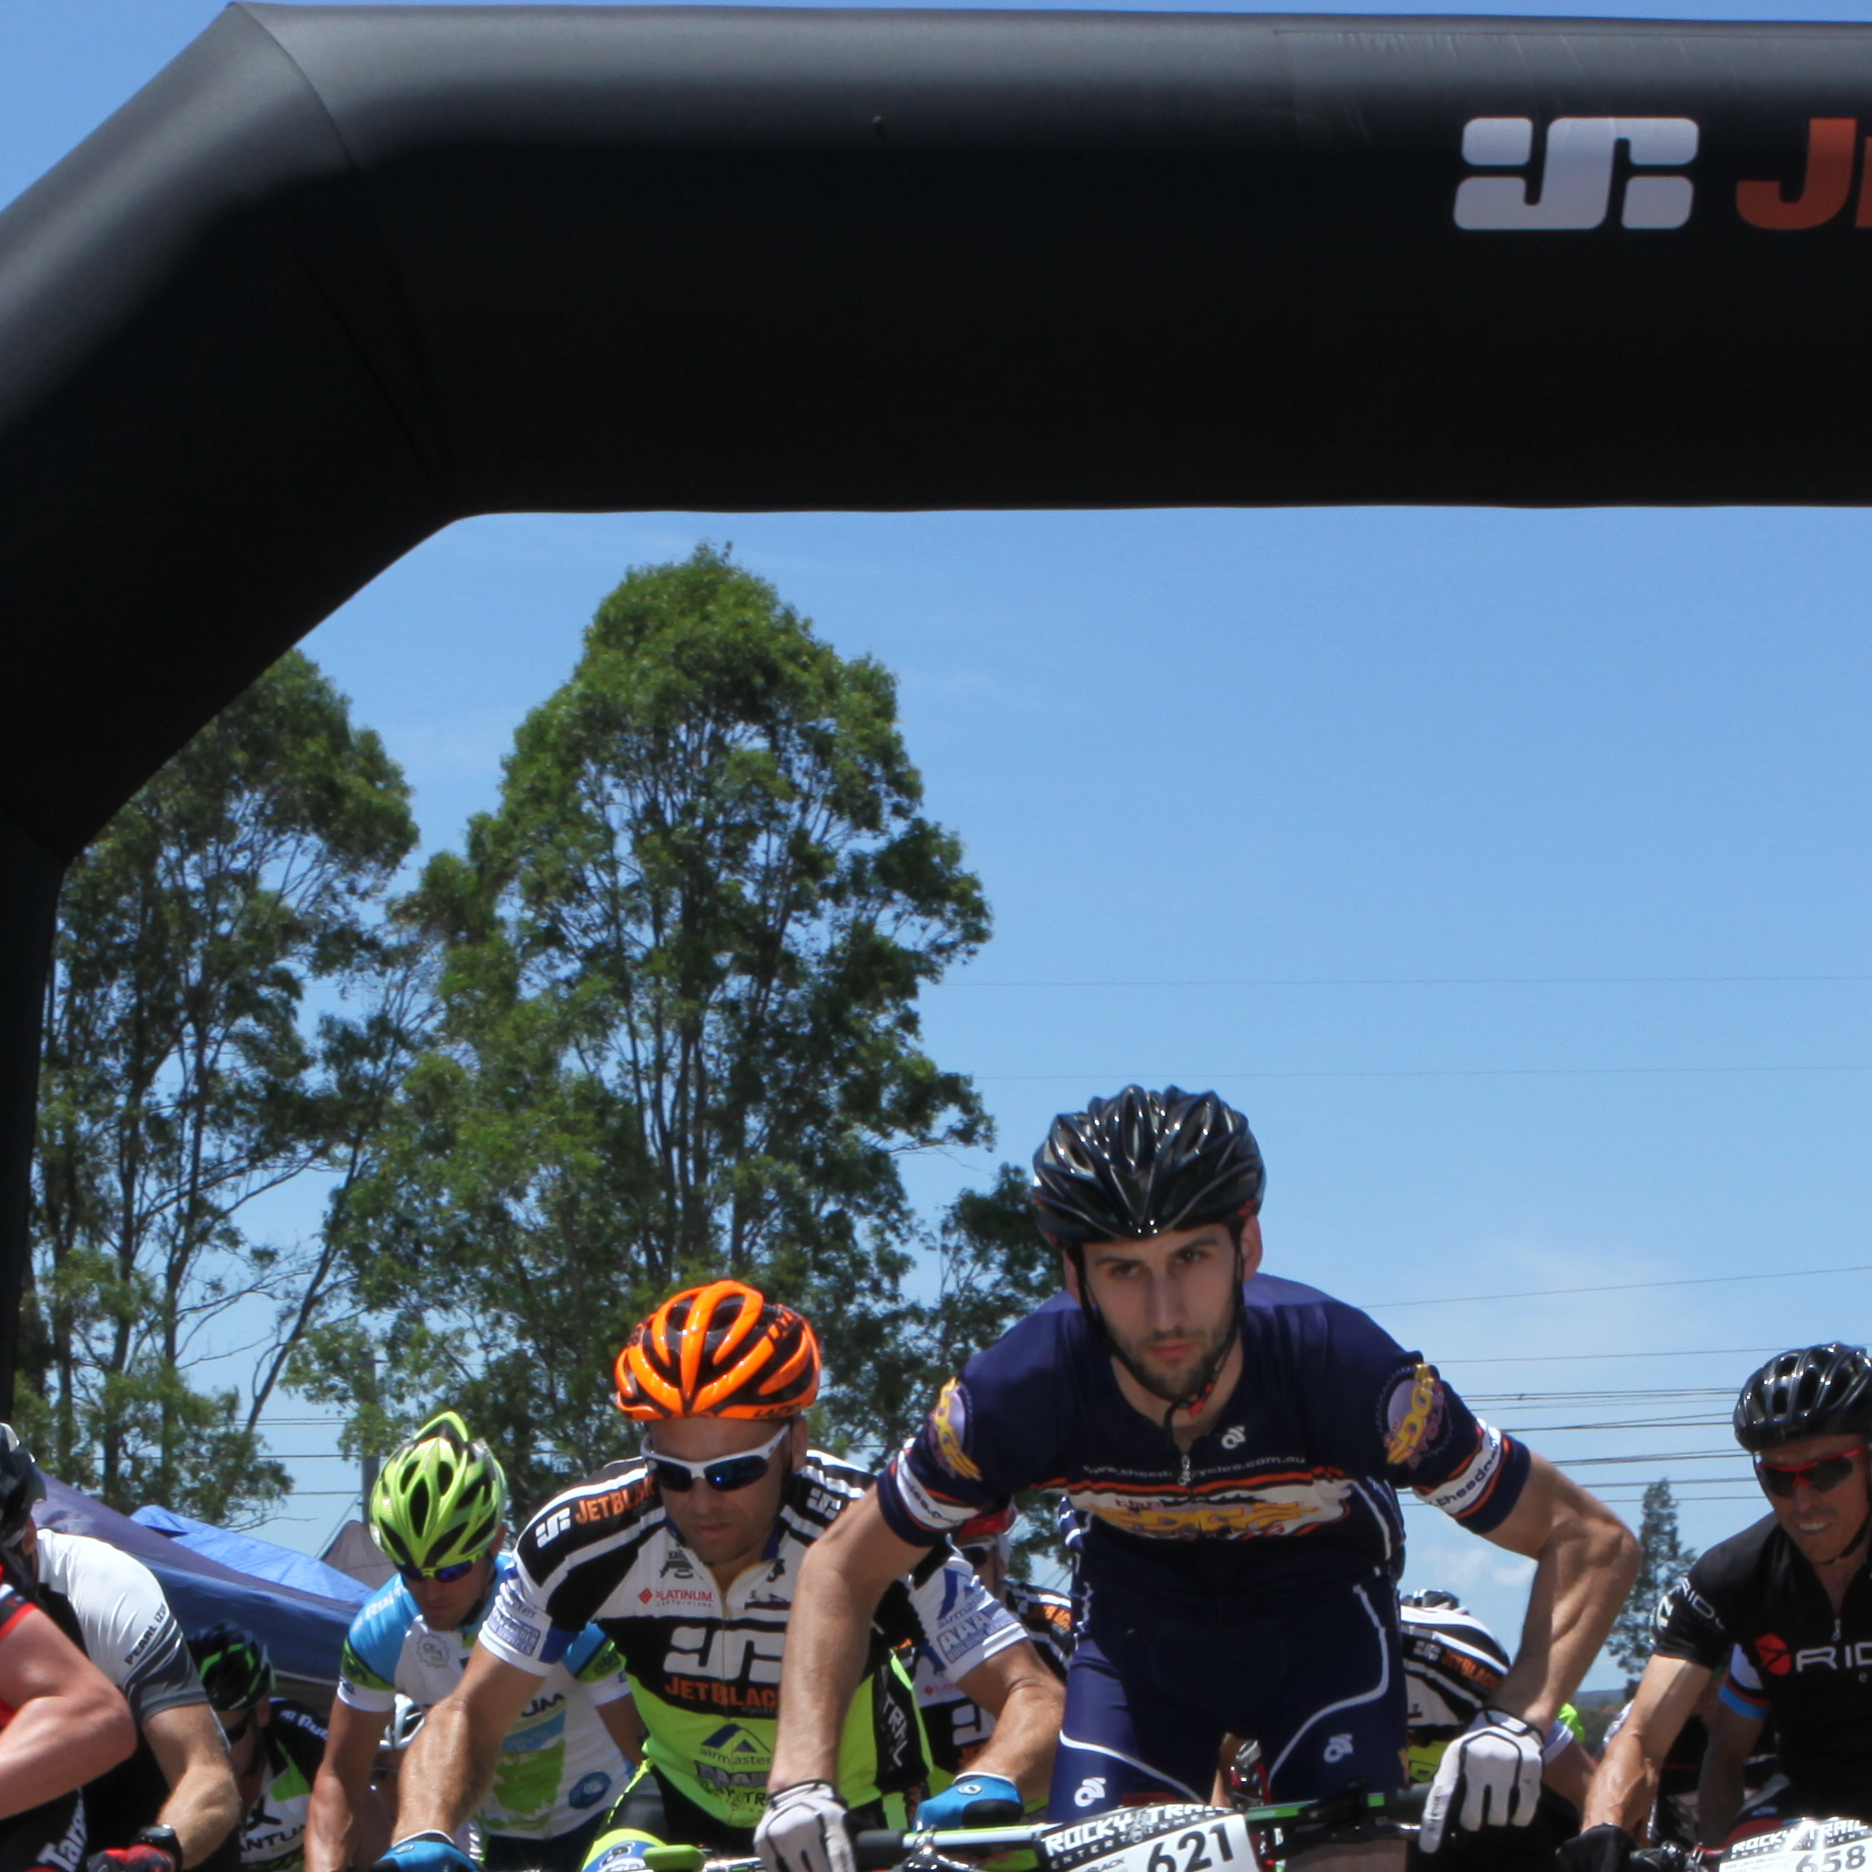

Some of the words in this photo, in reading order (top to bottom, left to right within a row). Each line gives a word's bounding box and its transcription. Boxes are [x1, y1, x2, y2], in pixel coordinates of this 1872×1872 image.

[1681, 1577, 1726, 1630] RID
[124, 1622, 159, 1667] PEARL
[664, 1676, 779, 1709] JETBLAC
[1042, 1813, 1133, 1857] ROCKY
[1806, 1819, 1869, 1840] TRAIL
